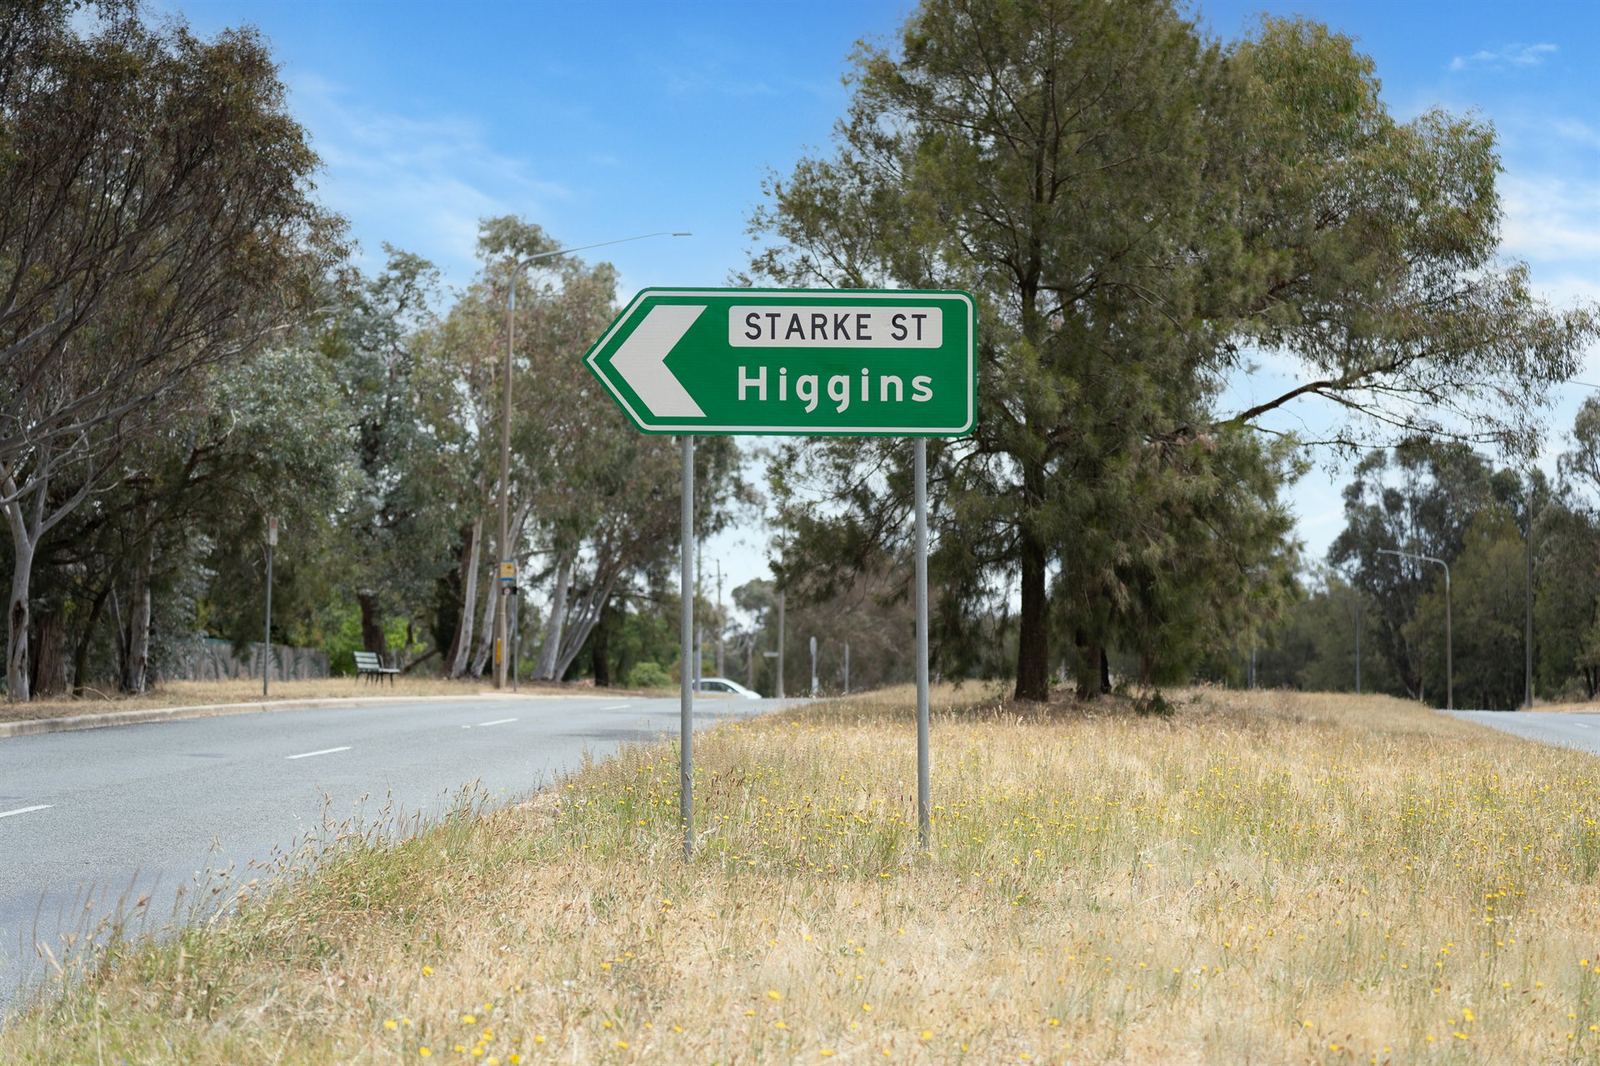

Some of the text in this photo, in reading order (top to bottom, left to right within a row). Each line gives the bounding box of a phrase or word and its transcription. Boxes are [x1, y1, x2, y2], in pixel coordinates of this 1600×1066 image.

[745, 312, 928, 341] STARKE ST
[737, 366, 934, 414] Higgins
